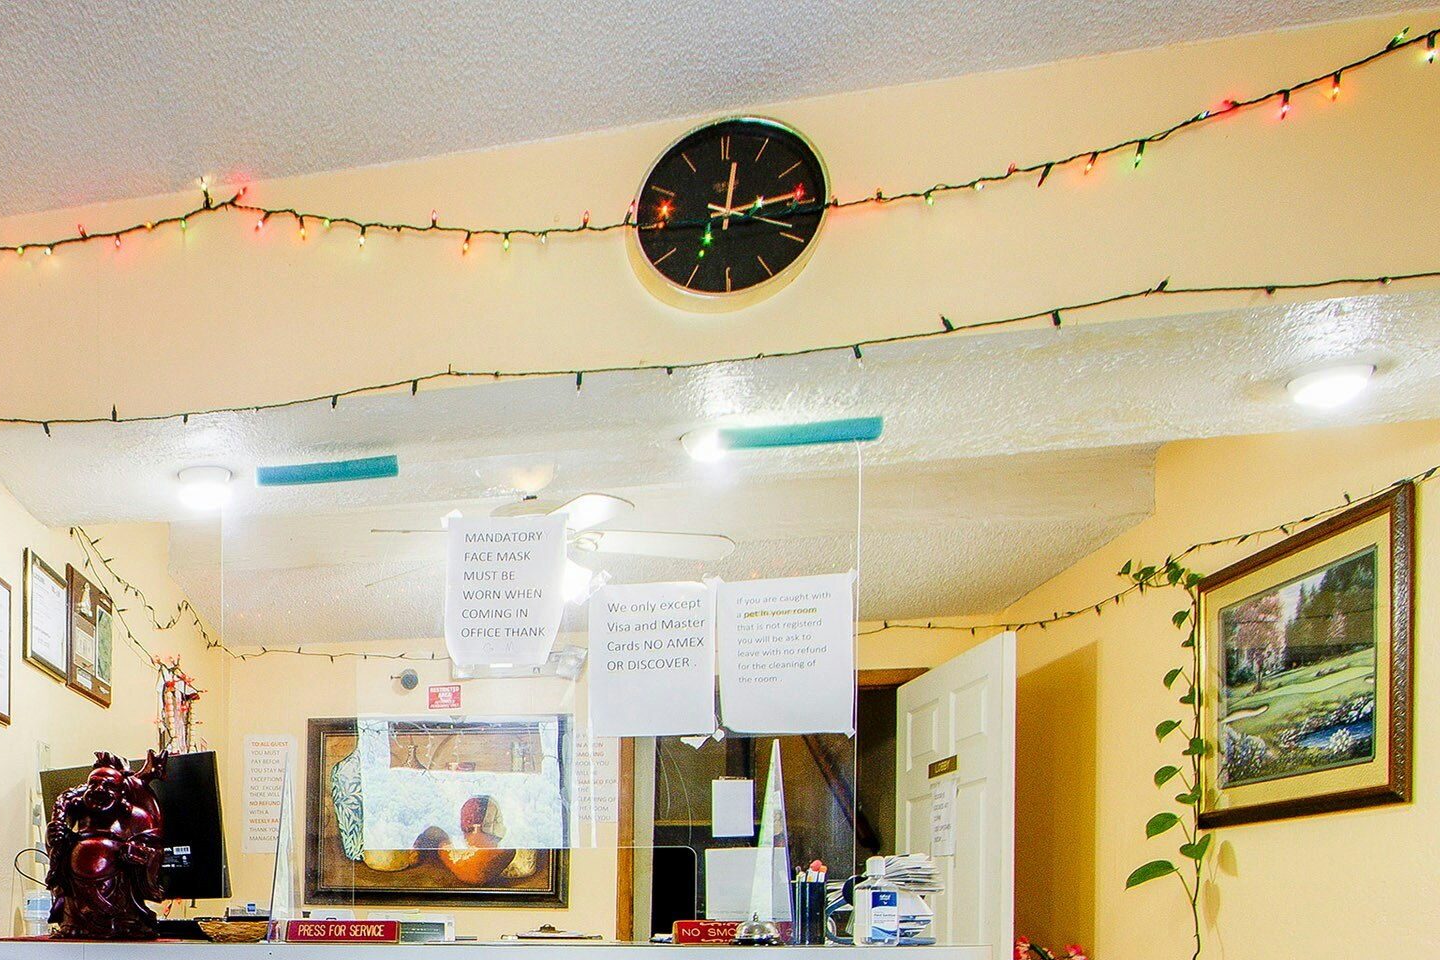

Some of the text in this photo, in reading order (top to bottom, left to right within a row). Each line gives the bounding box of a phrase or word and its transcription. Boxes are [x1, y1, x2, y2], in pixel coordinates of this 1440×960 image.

[465, 531, 544, 544] MANDATORY
[464, 551, 532, 562] FACE MASK
[463, 571, 516, 581] MUST BE
[462, 588, 543, 600] WORN WHEN
[744, 598, 761, 606] you
[780, 593, 809, 602] caught
[811, 592, 832, 600] with
[607, 598, 702, 614] We only except
[461, 608, 528, 619] COMING IN
[607, 618, 705, 632] Visa and Master
[737, 624, 754, 632] that
[782, 618, 822, 630] registerd
[461, 627, 546, 638] OFFICE THANK
[607, 636, 705, 652] Cards NO AMEX
[737, 638, 753, 646] you
[755, 636, 770, 644] will
[738, 650, 760, 658] leave
[762, 648, 780, 656] with
[797, 646, 827, 654] refund
[606, 658, 690, 671] OR DISCOVER
[752, 662, 766, 670] the
[768, 660, 805, 669] cleaning
[738, 676, 752, 684] the
[298, 924, 384, 937] PRESS FOR SERVICE
[682, 928, 700, 937] NO
